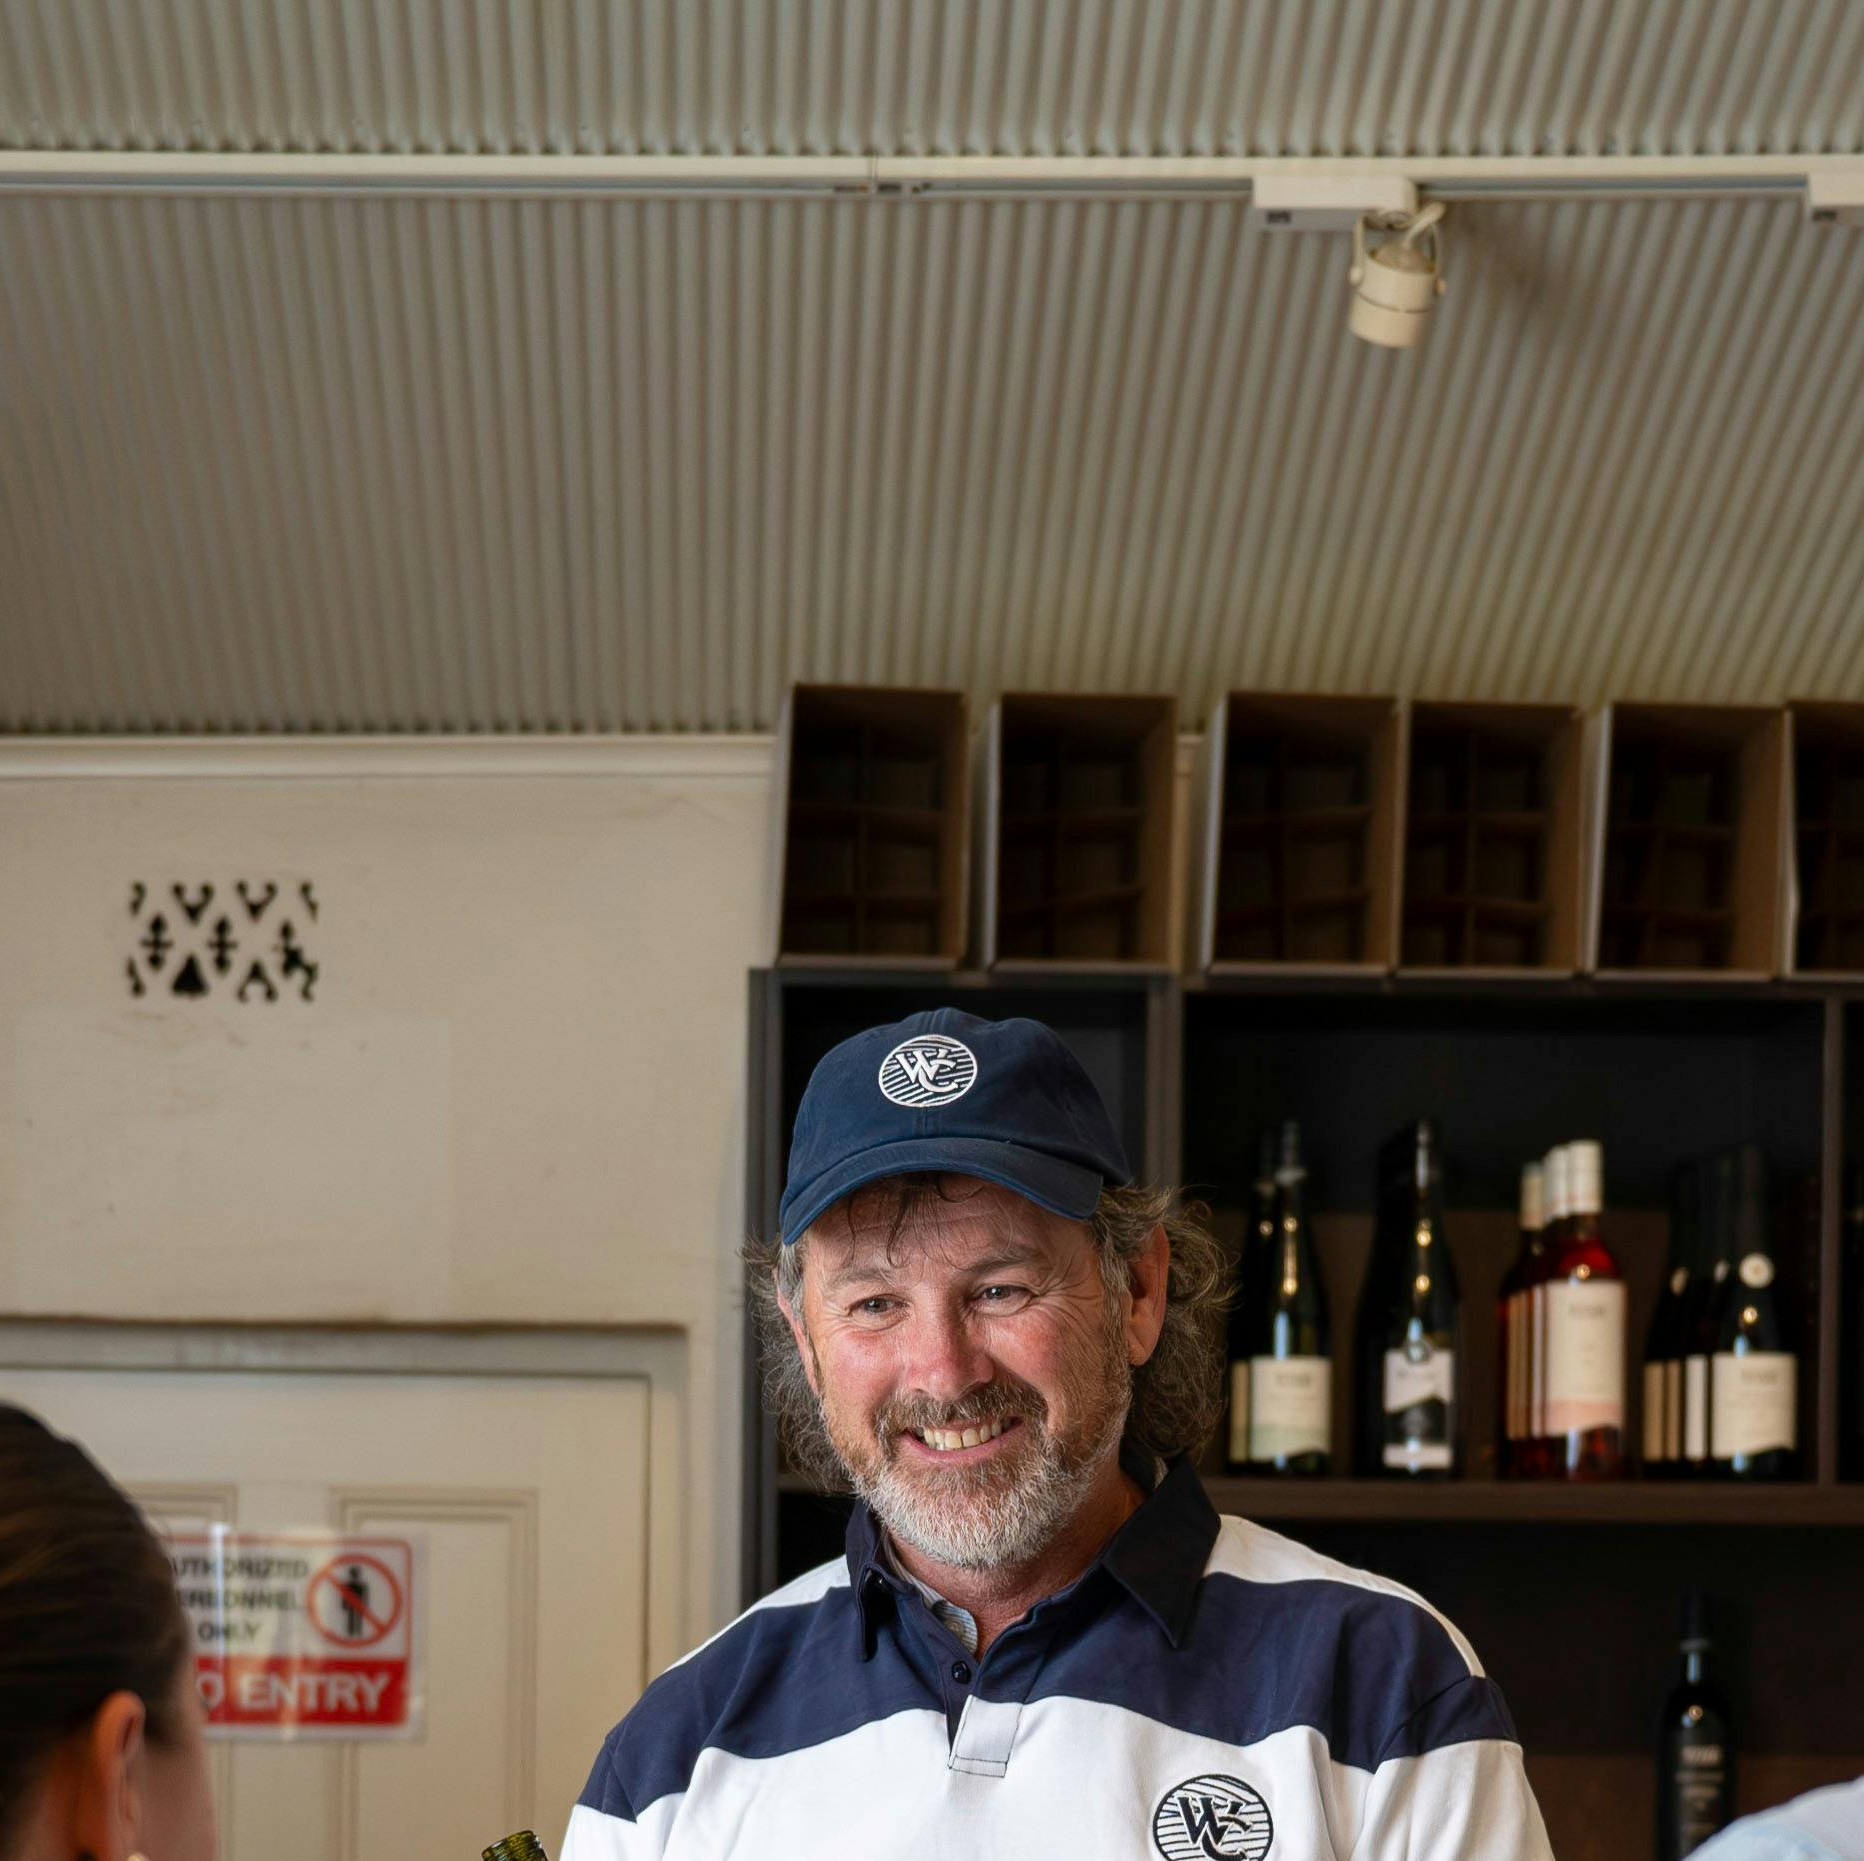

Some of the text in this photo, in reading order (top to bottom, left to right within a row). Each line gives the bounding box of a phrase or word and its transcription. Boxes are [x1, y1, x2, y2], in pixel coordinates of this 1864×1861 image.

[172, 1556, 309, 1580] UTHORIZED
[182, 1587, 301, 1610] ERSONNEL
[238, 1672, 391, 1713] ENTRY
